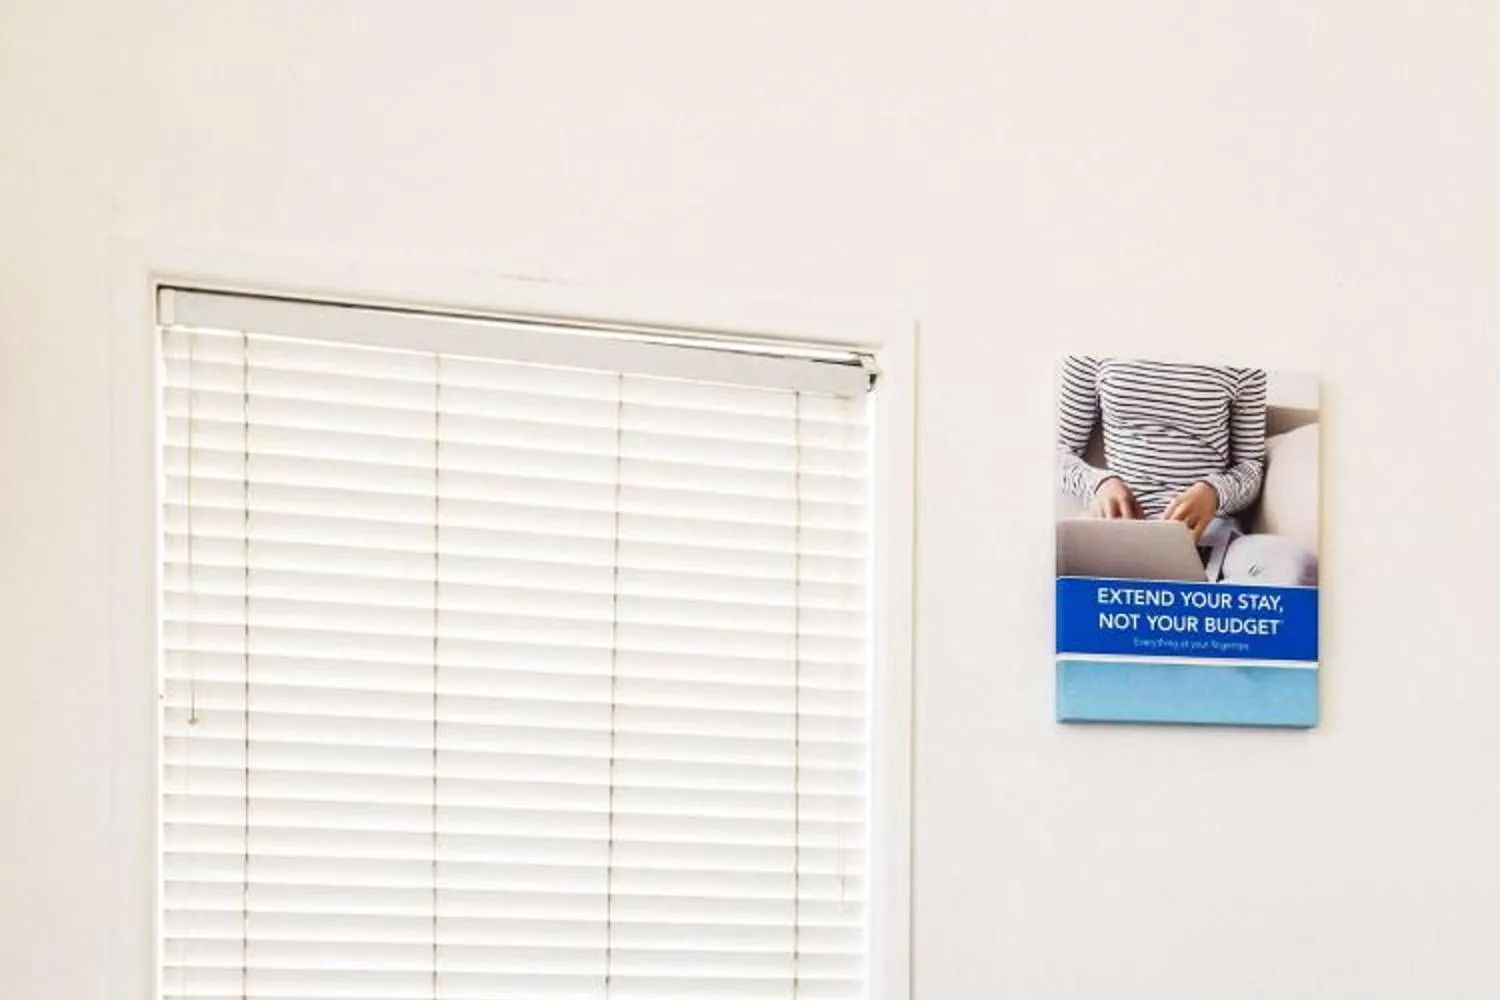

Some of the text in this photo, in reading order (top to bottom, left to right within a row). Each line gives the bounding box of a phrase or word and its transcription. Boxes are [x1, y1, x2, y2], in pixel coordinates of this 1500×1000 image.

[1097, 587, 1284, 613] EXTEND YOUR STAY,
[1099, 613, 1141, 630] NOT
[1147, 615, 1199, 633] YOUR
